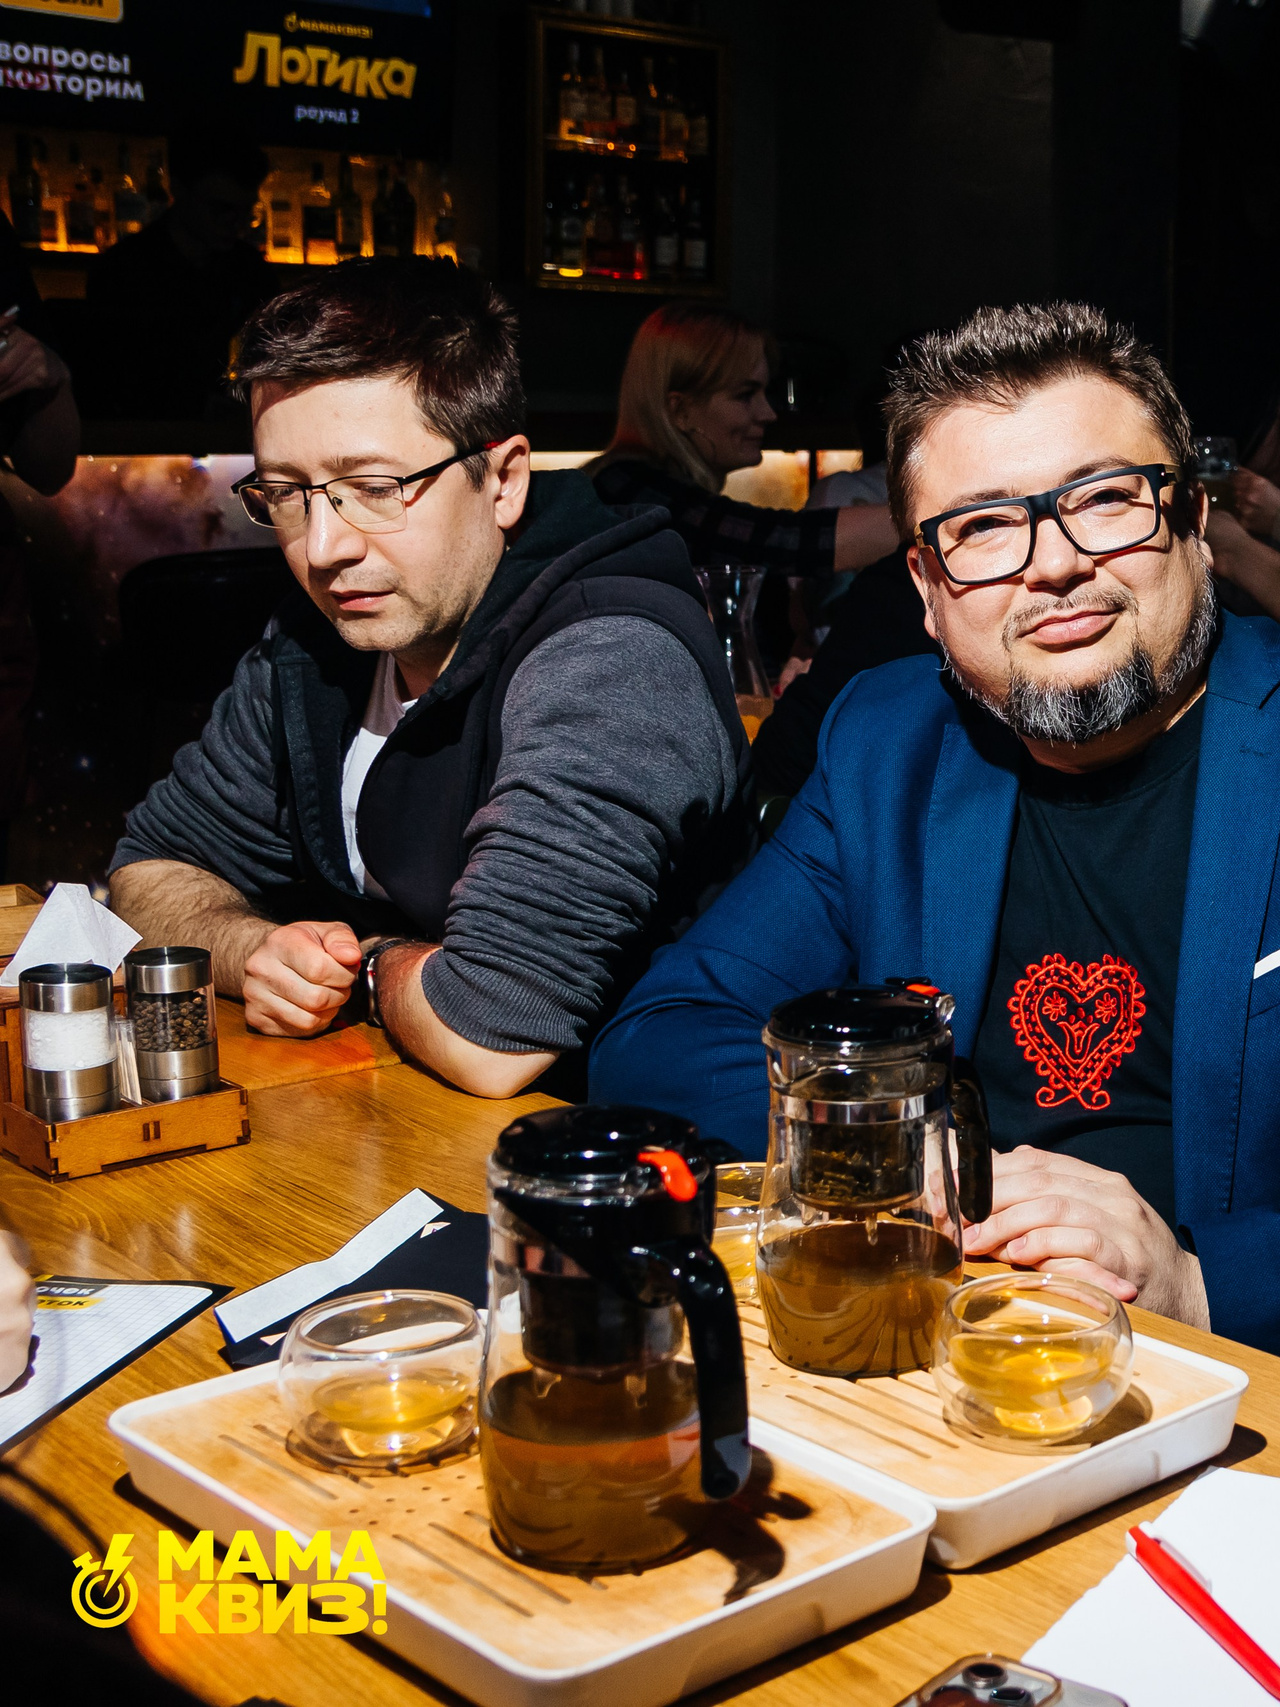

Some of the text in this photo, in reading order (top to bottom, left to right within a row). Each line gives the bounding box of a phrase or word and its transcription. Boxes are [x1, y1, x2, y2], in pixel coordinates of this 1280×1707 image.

[0, 41, 131, 74] вопросы
[233, 31, 417, 98] Логика
[296, 104, 359, 124] раунд 2
[36, 1286, 95, 1295] ОЧОК
